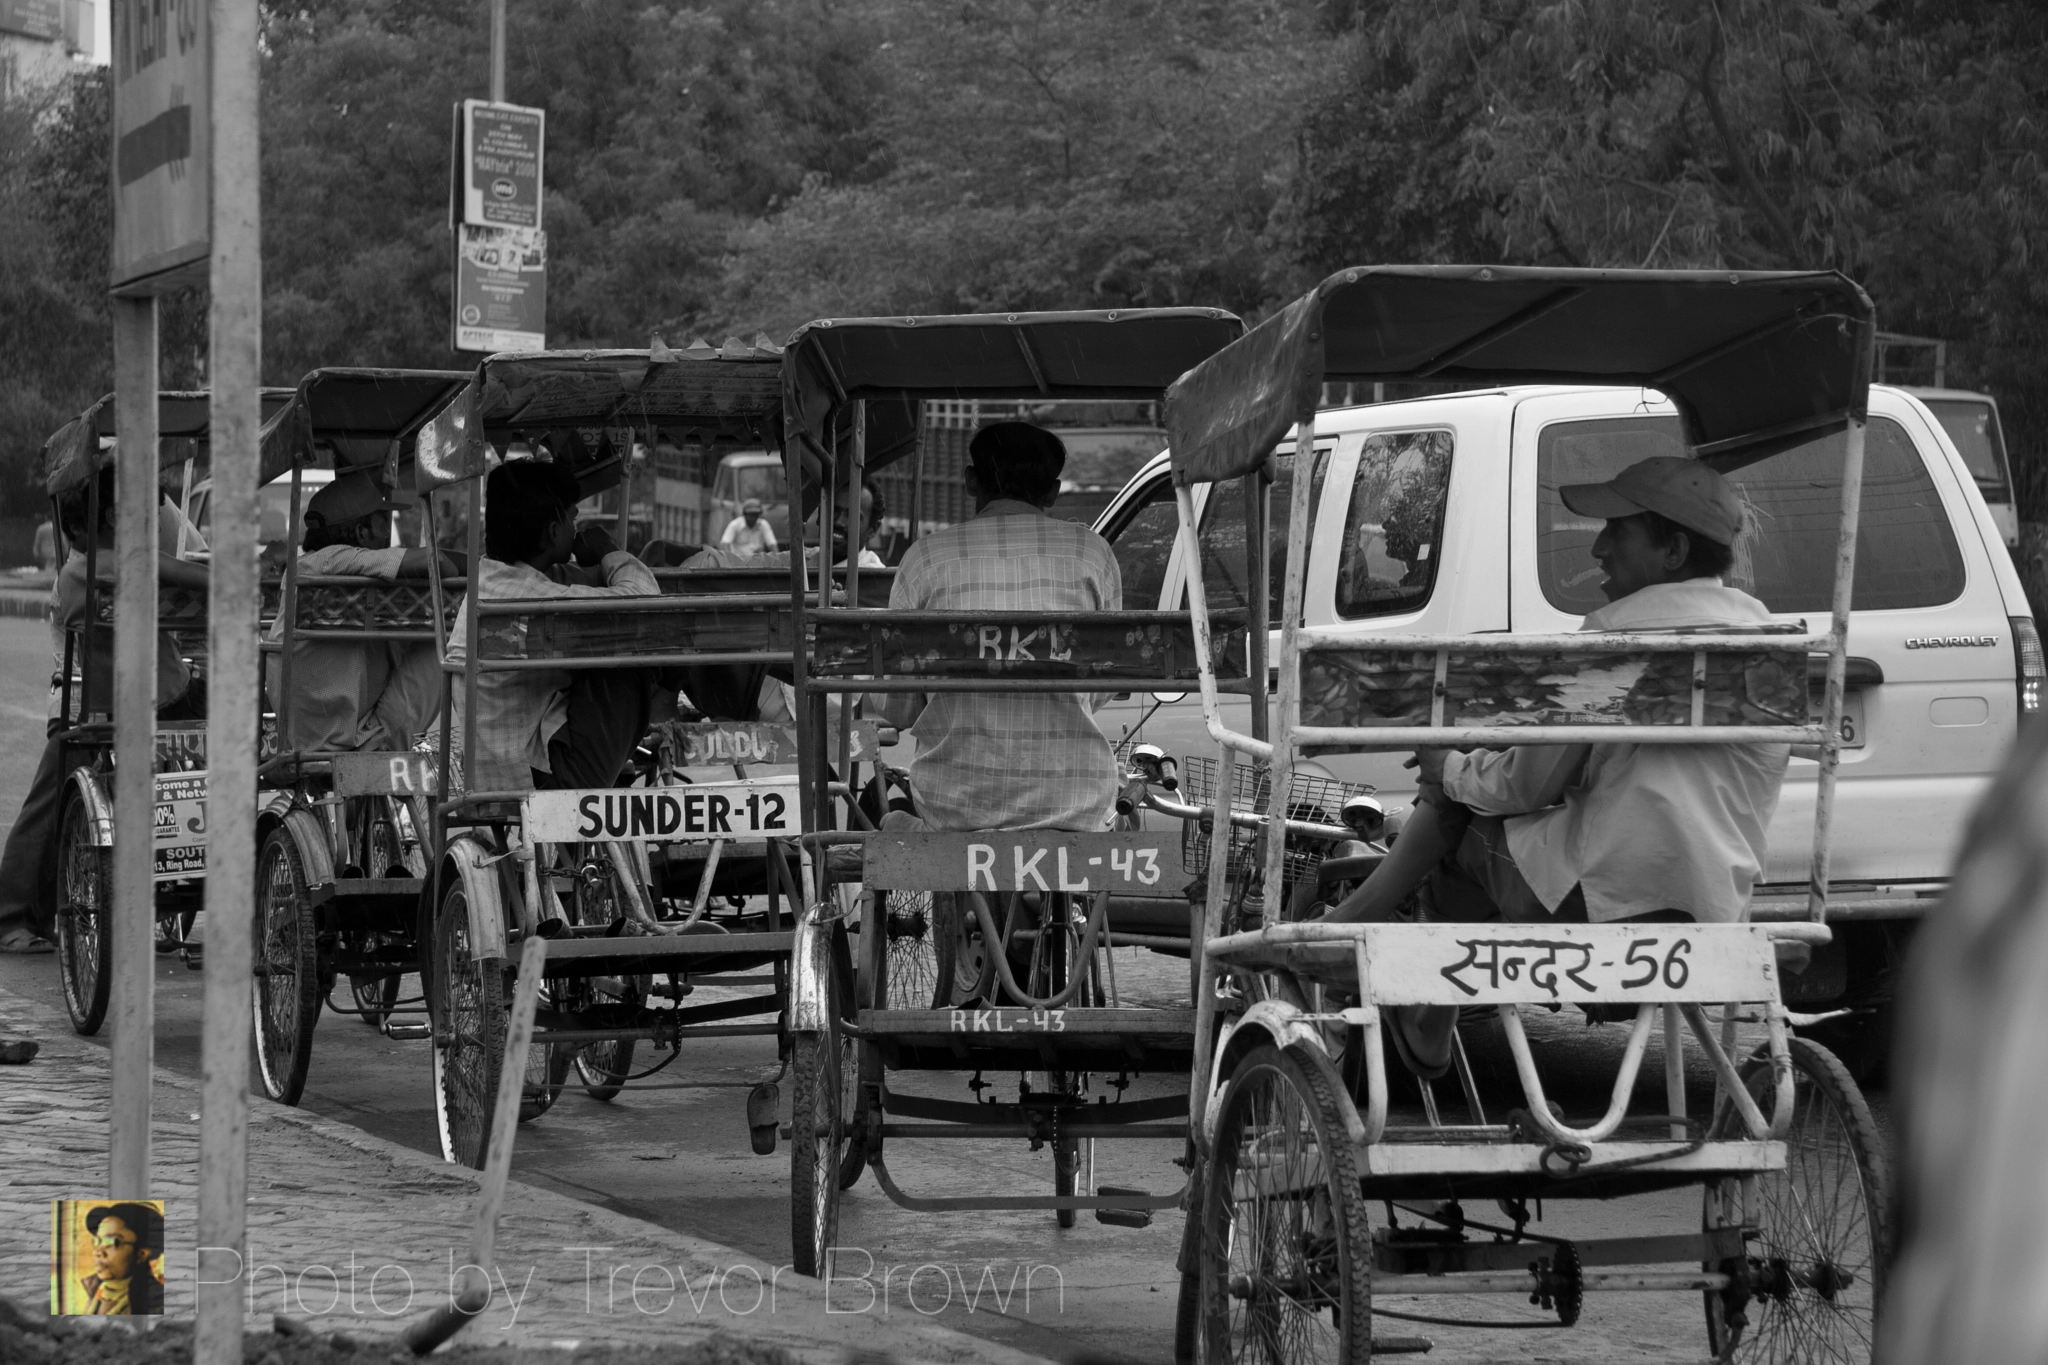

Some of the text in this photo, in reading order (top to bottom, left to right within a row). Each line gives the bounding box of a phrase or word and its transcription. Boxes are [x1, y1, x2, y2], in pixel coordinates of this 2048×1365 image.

[979, 626, 1072, 661] RKL
[1906, 635, 1999, 649] CHEVROLET
[163, 790, 173, 801] &
[577, 792, 786, 838] SUNDER-12
[166, 860, 183, 872] Ring
[184, 858, 205, 869] Road,
[968, 844, 1160, 891] RKL-43
[950, 1009, 1065, 1032] RKL-43
